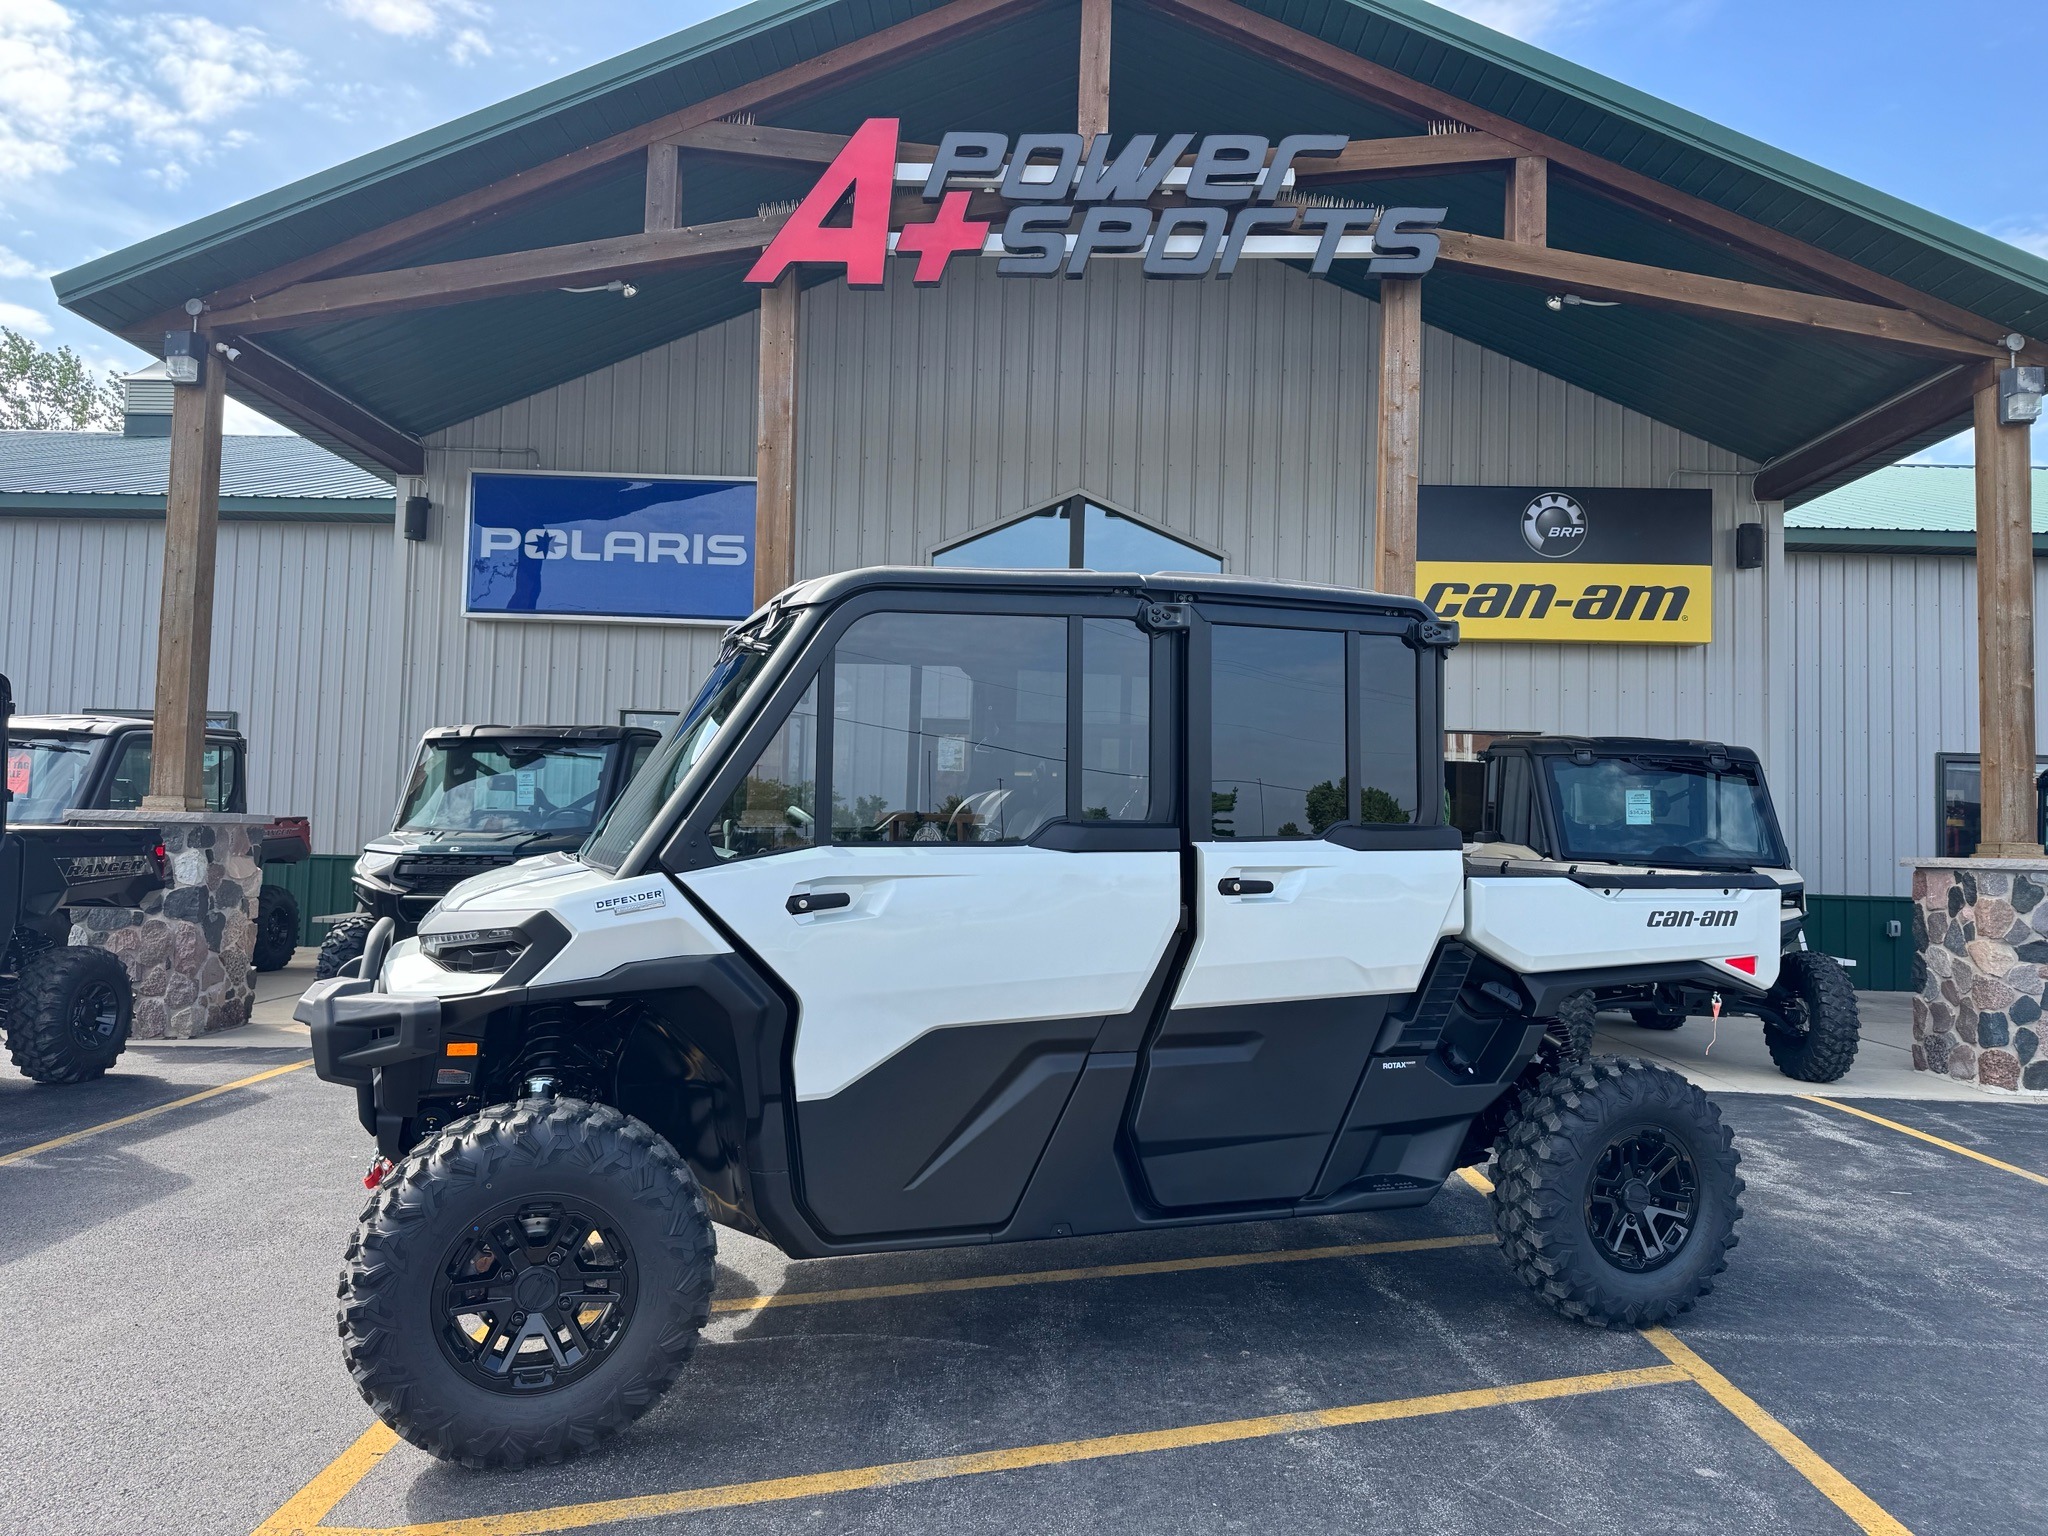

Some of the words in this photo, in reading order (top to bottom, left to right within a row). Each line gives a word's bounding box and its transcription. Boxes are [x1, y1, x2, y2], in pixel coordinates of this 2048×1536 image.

[743, 117, 990, 289] A+
[1547, 526, 1585, 538] BRP
[480, 527, 748, 566] POLARIS
[1422, 582, 1692, 621] can-am
[65, 859, 147, 877] RANGER
[595, 889, 663, 909] DEFENDER
[1646, 909, 1739, 928] can-am
[1382, 1061, 1407, 1070] ROTAX
